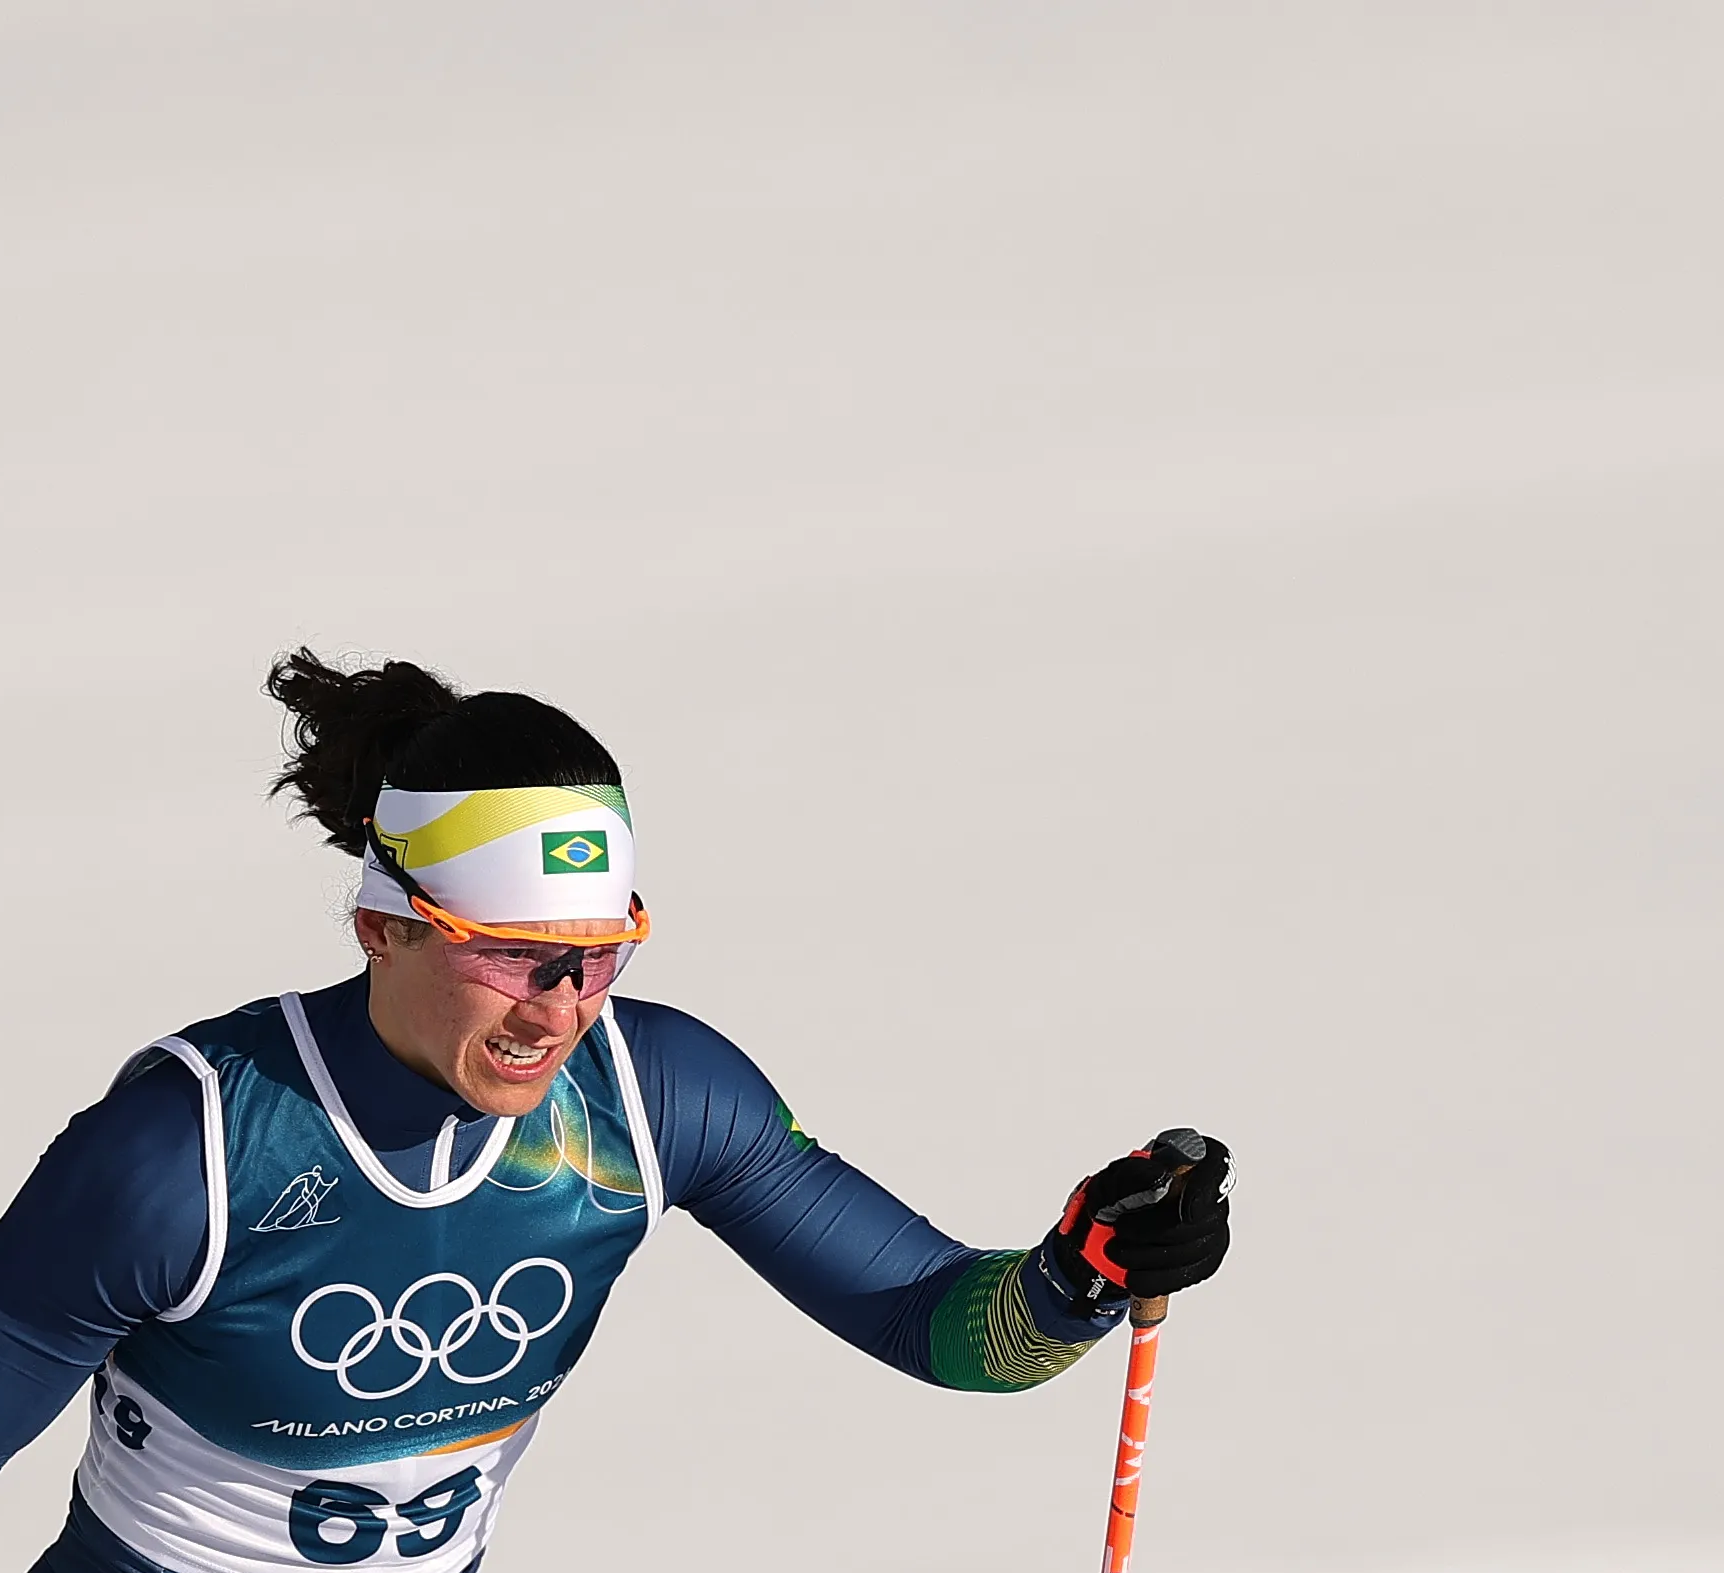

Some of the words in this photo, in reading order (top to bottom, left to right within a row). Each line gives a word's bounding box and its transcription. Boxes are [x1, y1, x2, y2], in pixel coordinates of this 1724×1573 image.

[1086, 1273, 1108, 1300] swix
[250, 1417, 388, 1437] MILANO
[393, 1396, 519, 1430] CORTINA
[524, 1366, 572, 1402] 202
[288, 1464, 483, 1565] 69
